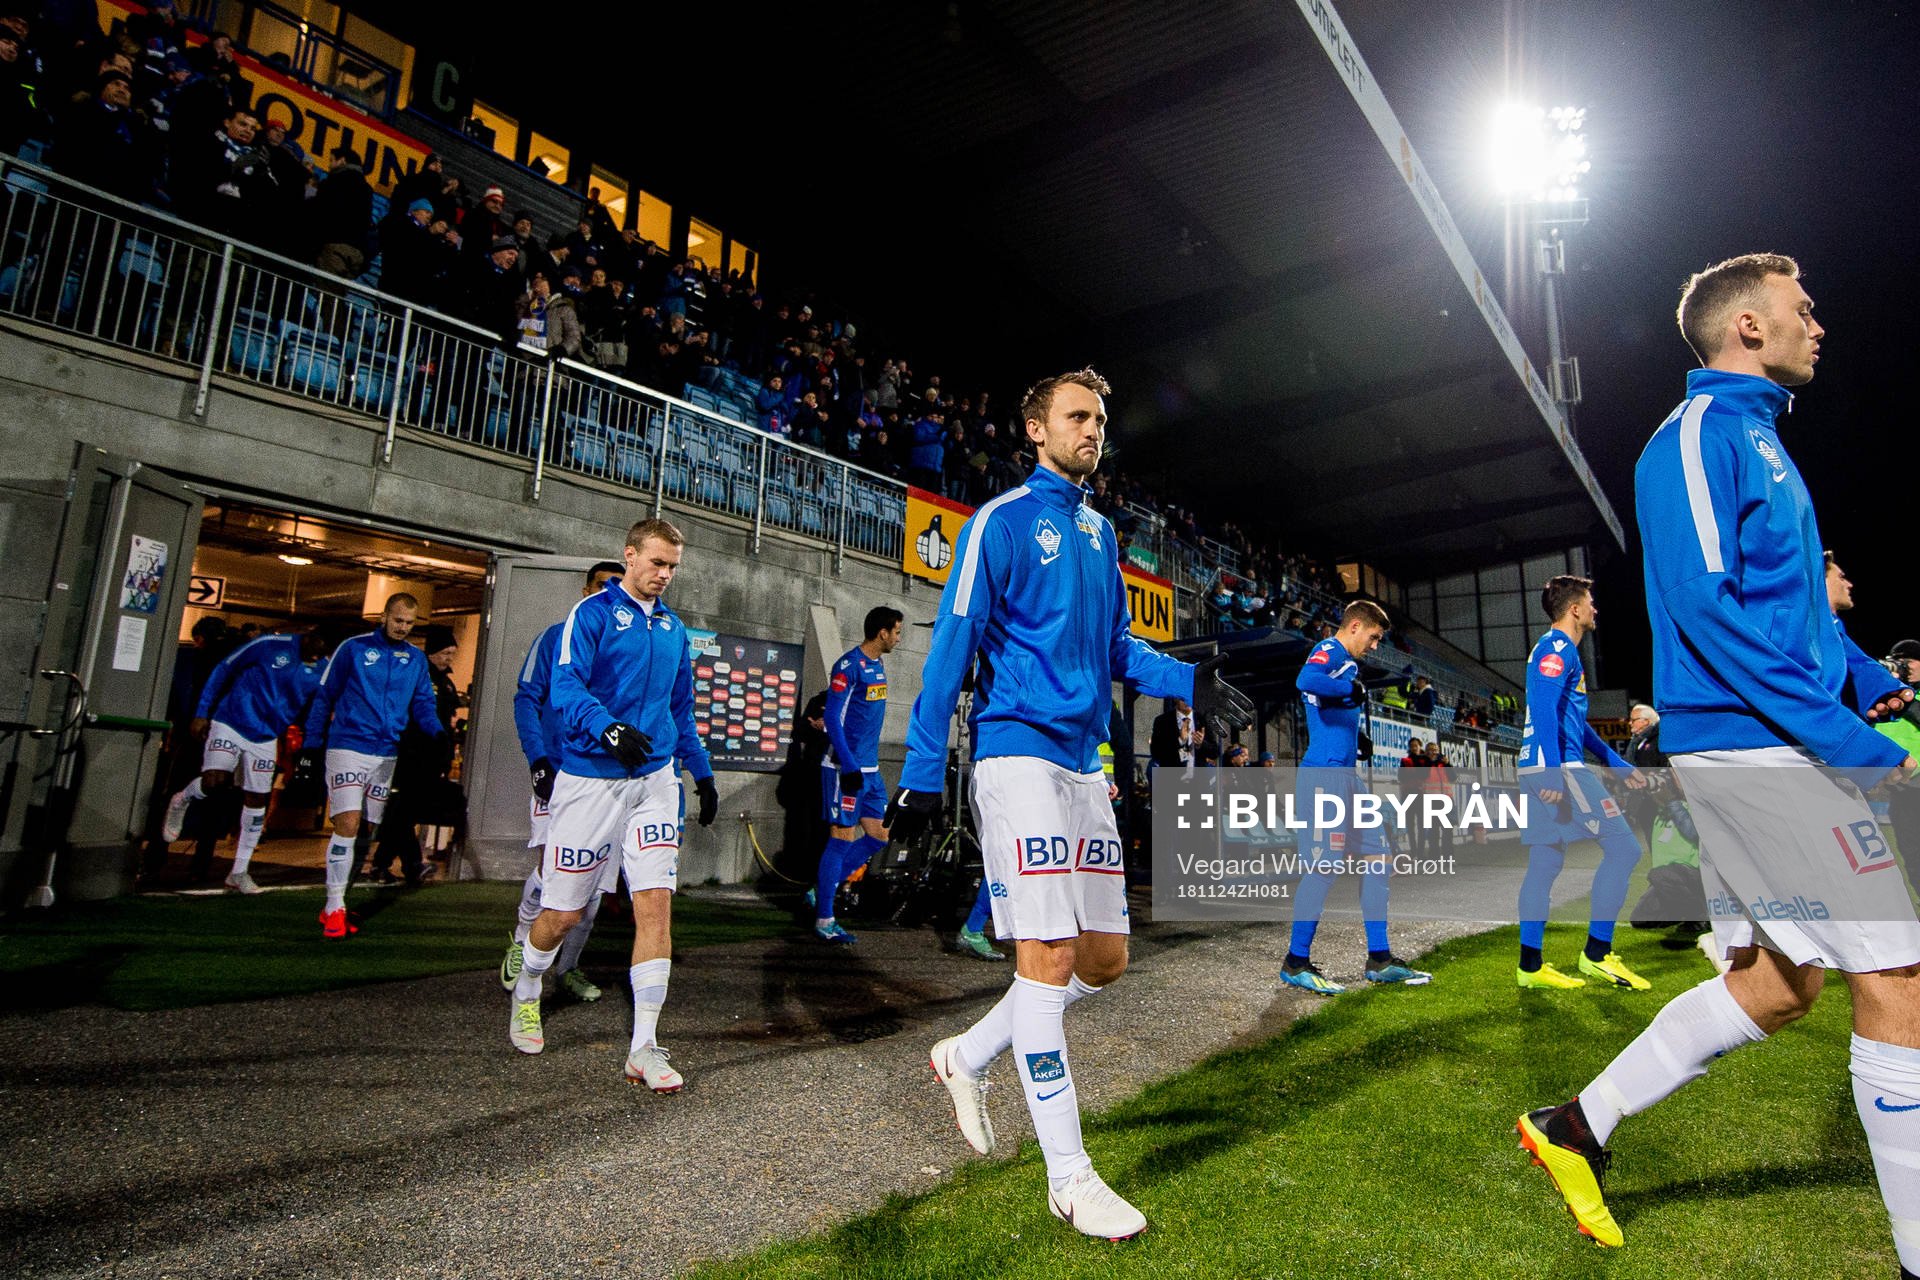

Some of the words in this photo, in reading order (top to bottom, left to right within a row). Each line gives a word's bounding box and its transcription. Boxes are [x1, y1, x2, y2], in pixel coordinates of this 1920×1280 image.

[1307, 0, 1366, 92] OMPLETT
[432, 61, 459, 112] C
[255, 93, 418, 187] OTUN
[1127, 583, 1169, 632] TUN
[1595, 724, 1627, 736] TUN
[257, 759, 275, 770] BD
[371, 785, 388, 798] BD
[643, 823, 678, 843] BD
[1025, 836, 1069, 866] BD
[1085, 839, 1121, 866] BD
[1034, 1069, 1063, 1079] AKER
